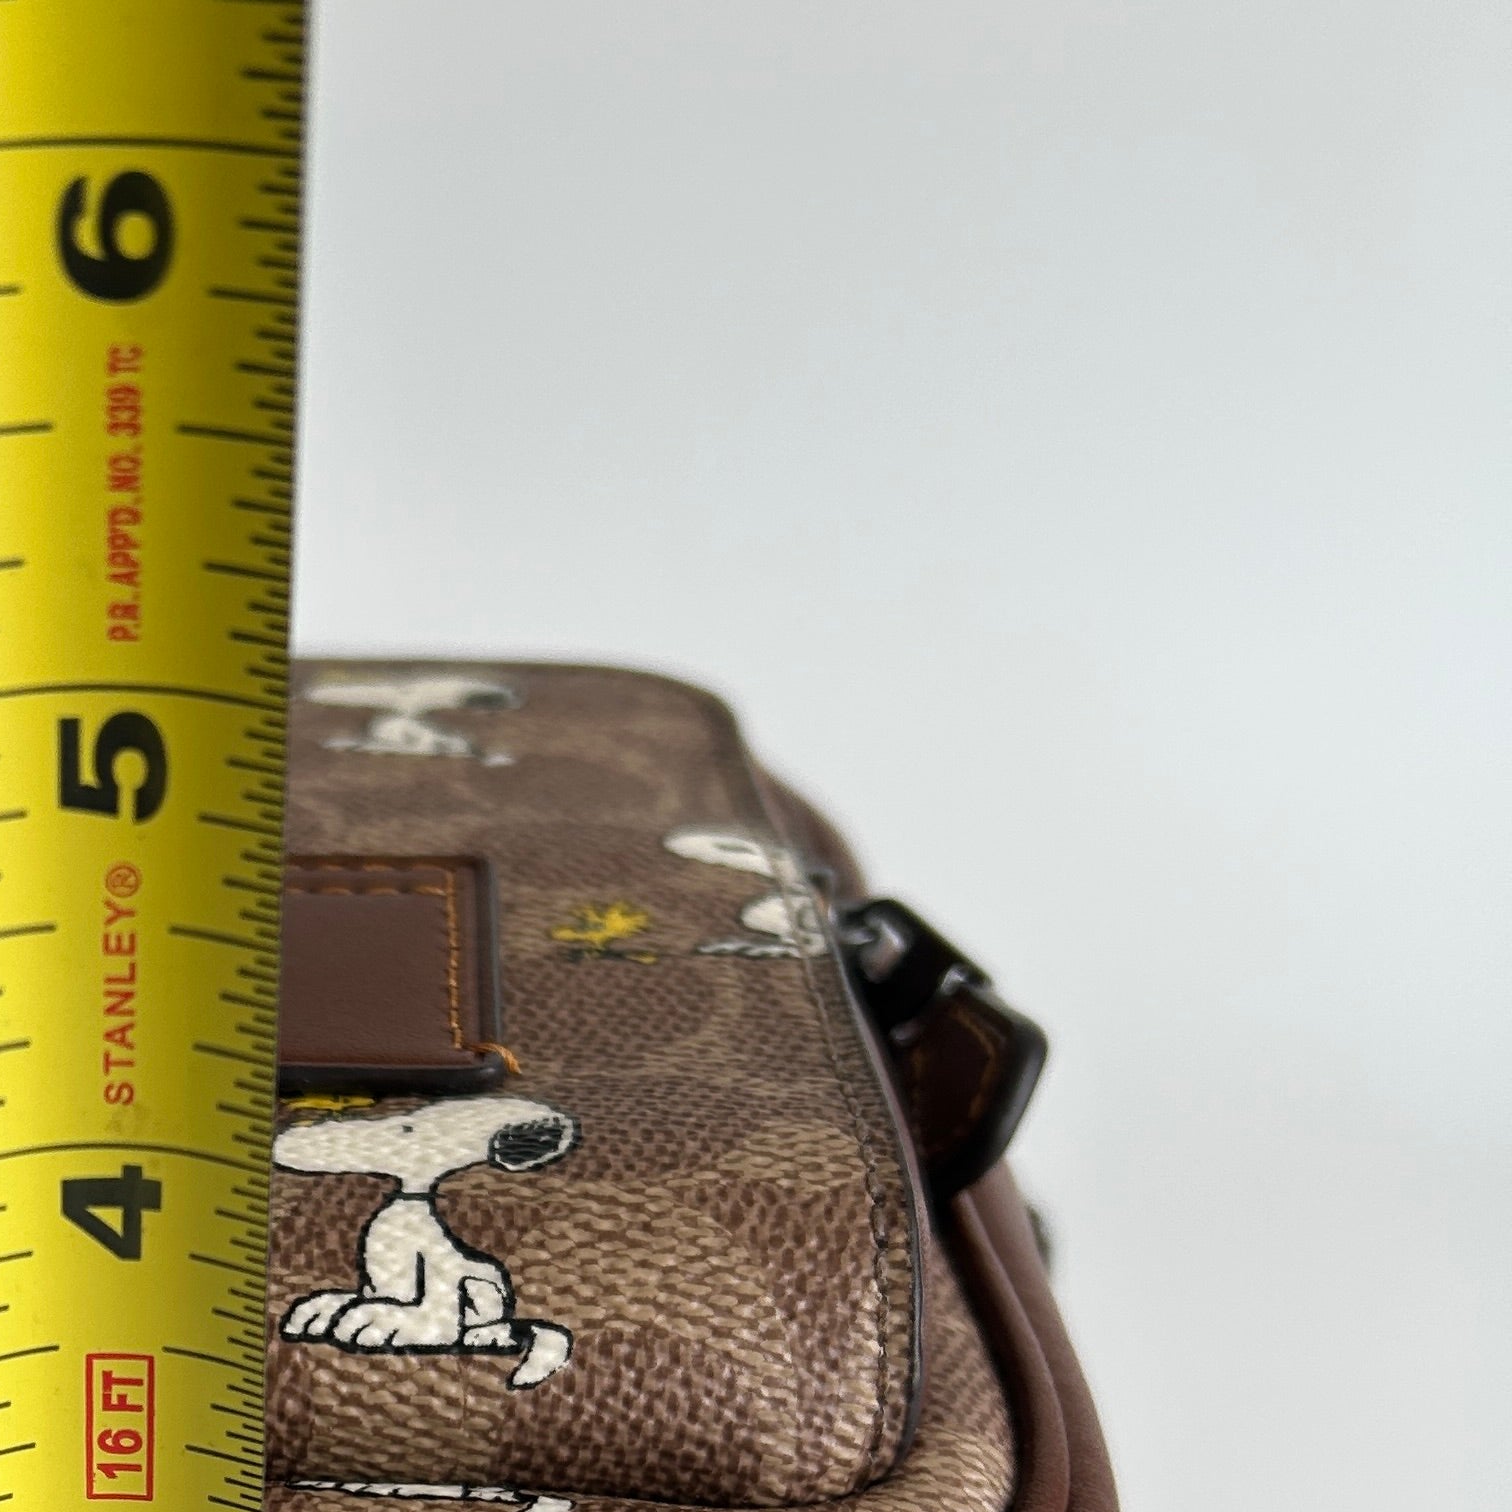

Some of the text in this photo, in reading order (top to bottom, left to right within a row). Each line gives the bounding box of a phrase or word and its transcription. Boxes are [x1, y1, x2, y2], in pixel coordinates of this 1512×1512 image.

[55, 169, 176, 305] 6
[106, 344, 144, 376] TC
[57, 711, 169, 825] 5
[61, 1164, 163, 1261] 4
[96, 1369, 144, 1480] 16 FT
